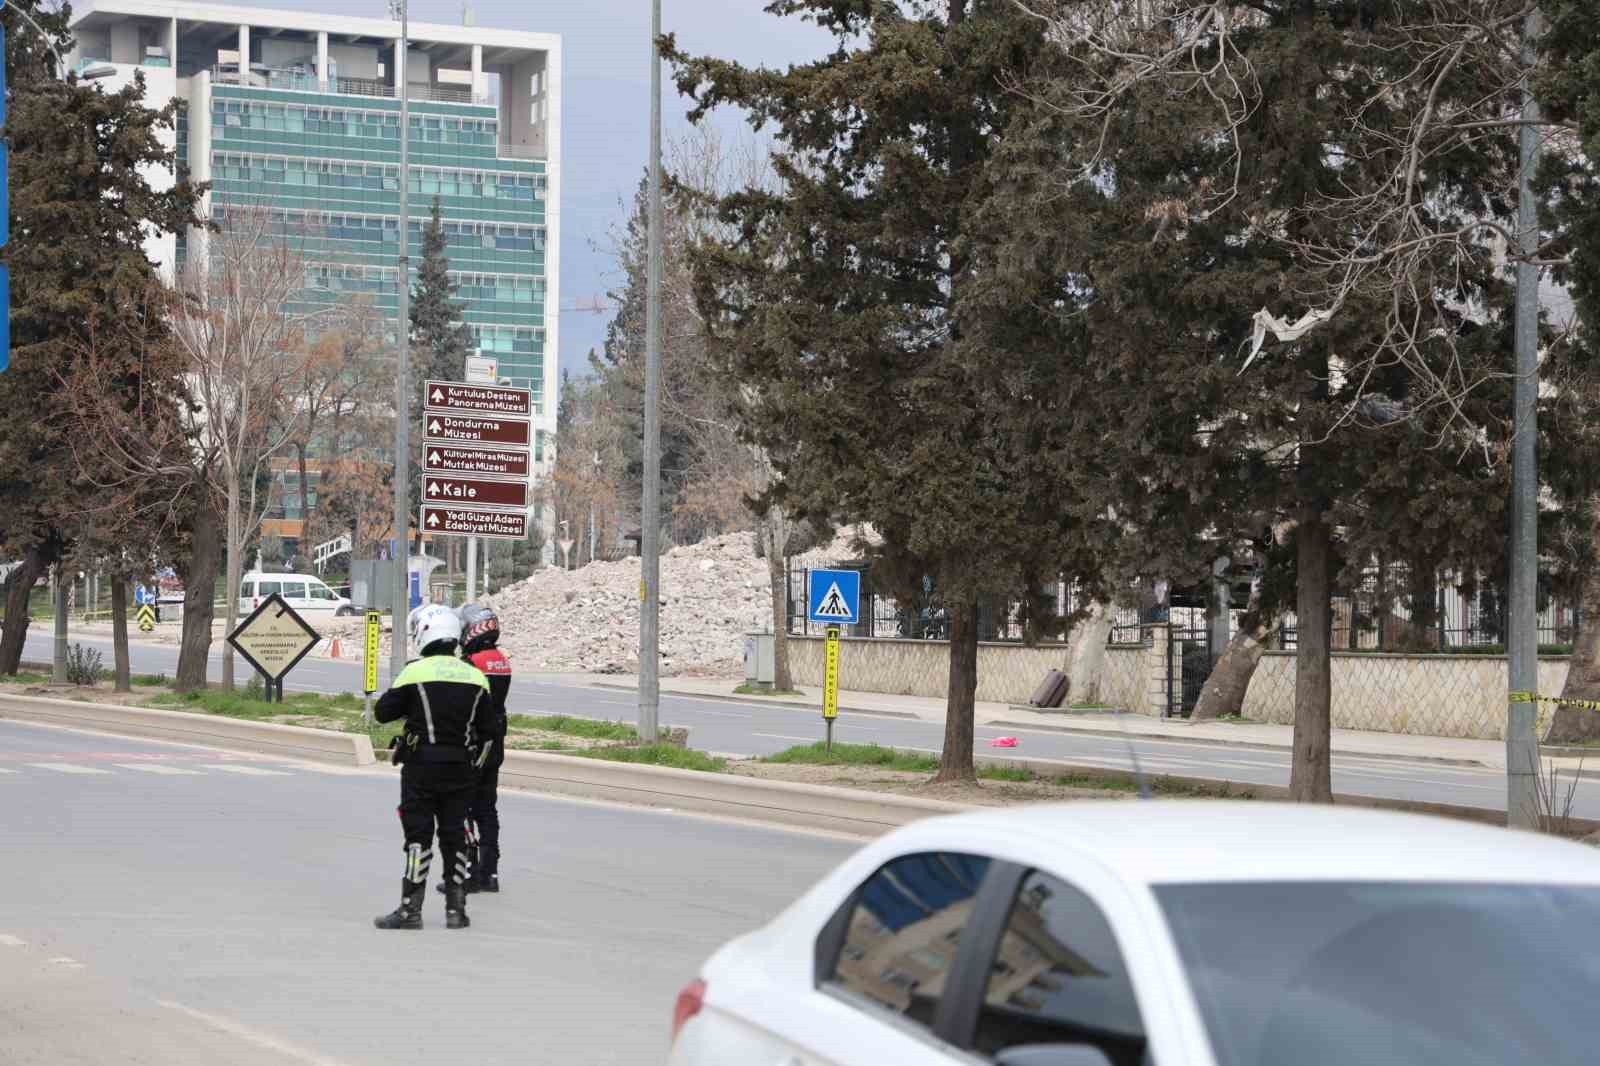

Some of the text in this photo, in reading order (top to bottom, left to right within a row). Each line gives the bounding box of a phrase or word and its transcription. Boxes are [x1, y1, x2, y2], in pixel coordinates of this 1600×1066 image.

[448, 397, 494, 409] Panorama
[444, 418, 500, 430] Dondurma
[444, 428, 481, 439] Müzesi
[475, 452, 496, 461] Miras
[444, 459, 475, 469] Mutfak
[443, 483, 477, 497] Kale
[446, 511, 466, 520] Yedi
[494, 514, 523, 524] Adam
[445, 519, 522, 534] Edebiyat Müzesi
